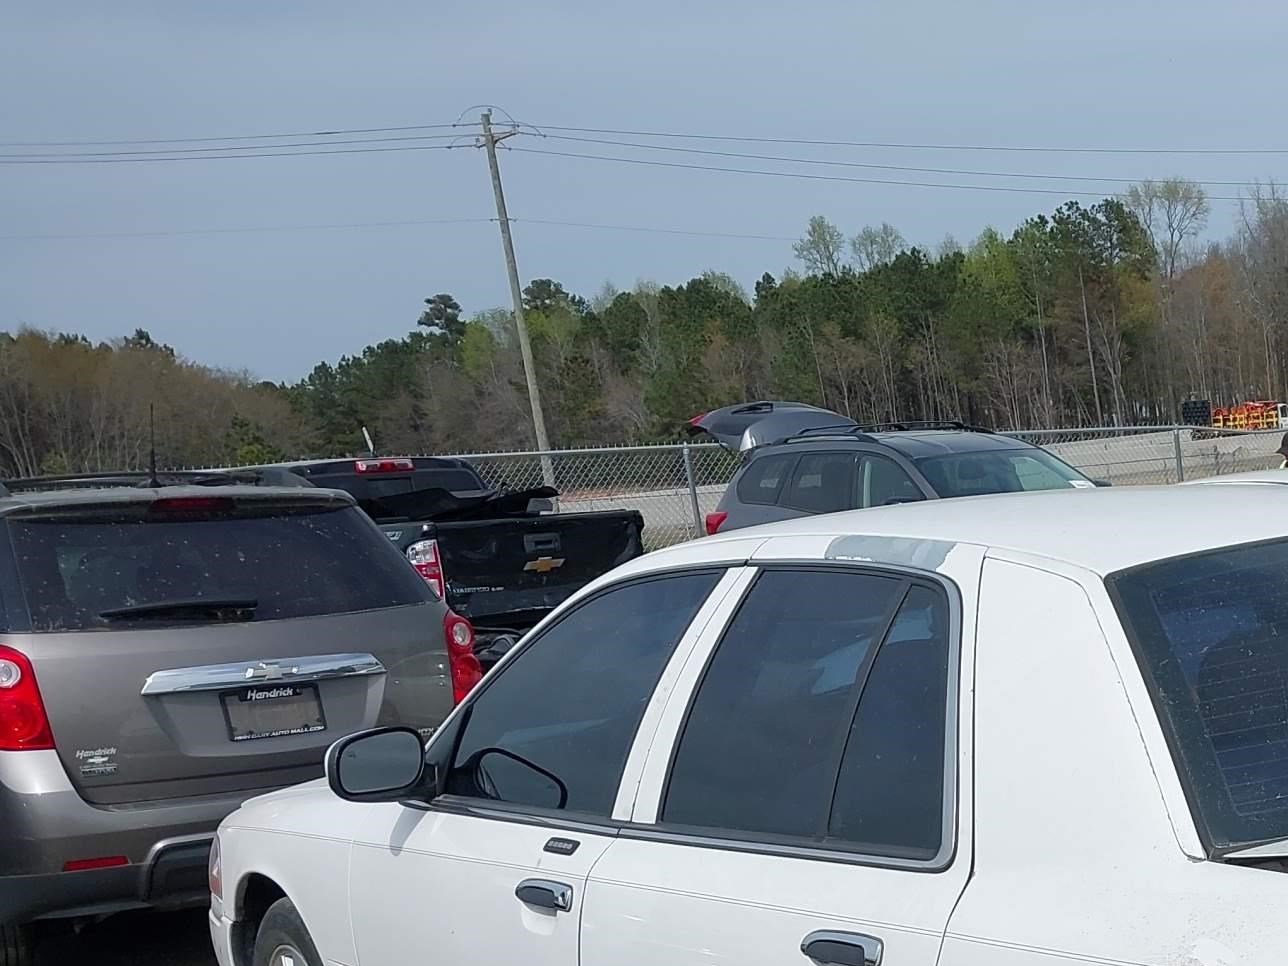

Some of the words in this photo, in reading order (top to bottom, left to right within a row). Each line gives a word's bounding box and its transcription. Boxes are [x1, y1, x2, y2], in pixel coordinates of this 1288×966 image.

[247, 687, 293, 701] Hendrick
[271, 729, 290, 737] AUTO
[75, 746, 118, 760] Hendrick
